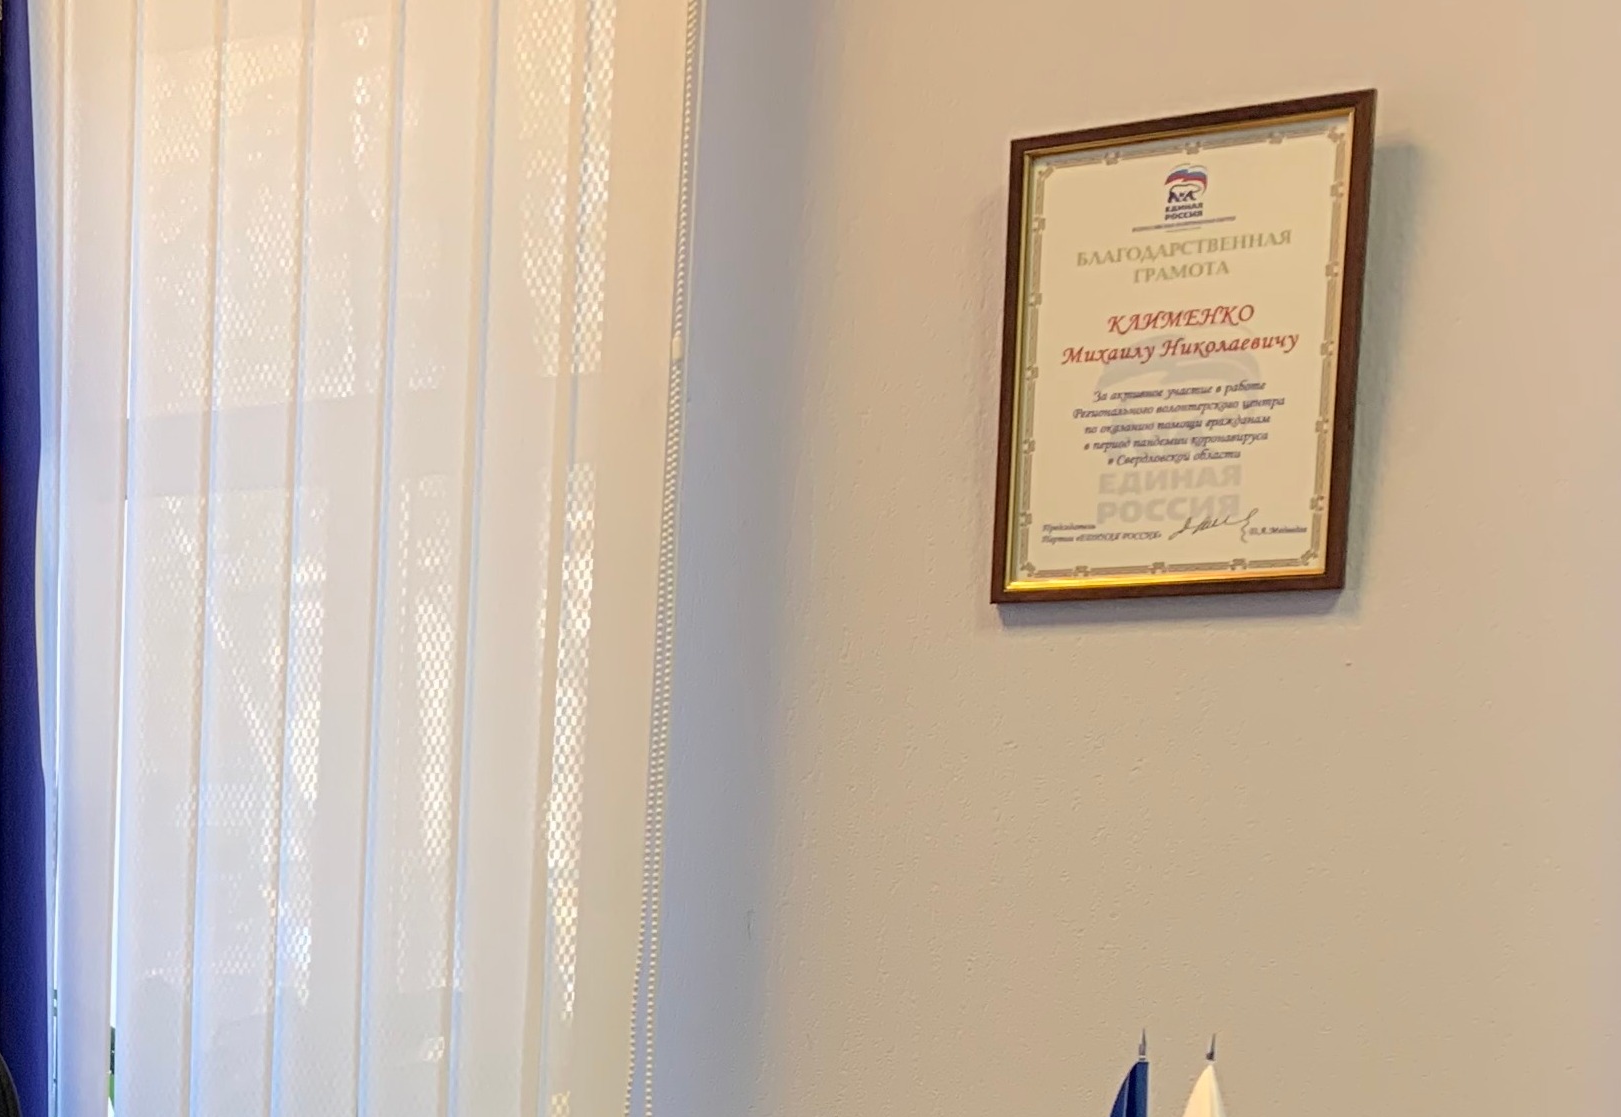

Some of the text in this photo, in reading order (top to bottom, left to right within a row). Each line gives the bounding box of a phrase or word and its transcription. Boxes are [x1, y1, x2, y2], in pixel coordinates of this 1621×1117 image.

[1076, 229, 1292, 267] БЛАГОДАРСТВЕННАЯ
[1133, 260, 1230, 284] ГРАМОТА
[1107, 304, 1255, 335] КЛИМЕНКО
[1061, 333, 1300, 366] Михаилу Николаевичу
[1166, 386, 1213, 400] участие
[1223, 379, 1267, 396] работе
[1157, 419, 1202, 430] помощи
[1205, 414, 1271, 431] гражданам
[1092, 439, 1131, 453] период
[1190, 431, 1269, 448] коронавируса
[1116, 452, 1191, 467] Свердловской
[1193, 449, 1241, 461] области
[1098, 464, 1242, 496] ЕДИНАЯ
[1096, 494, 1240, 525] РОССИЯ
